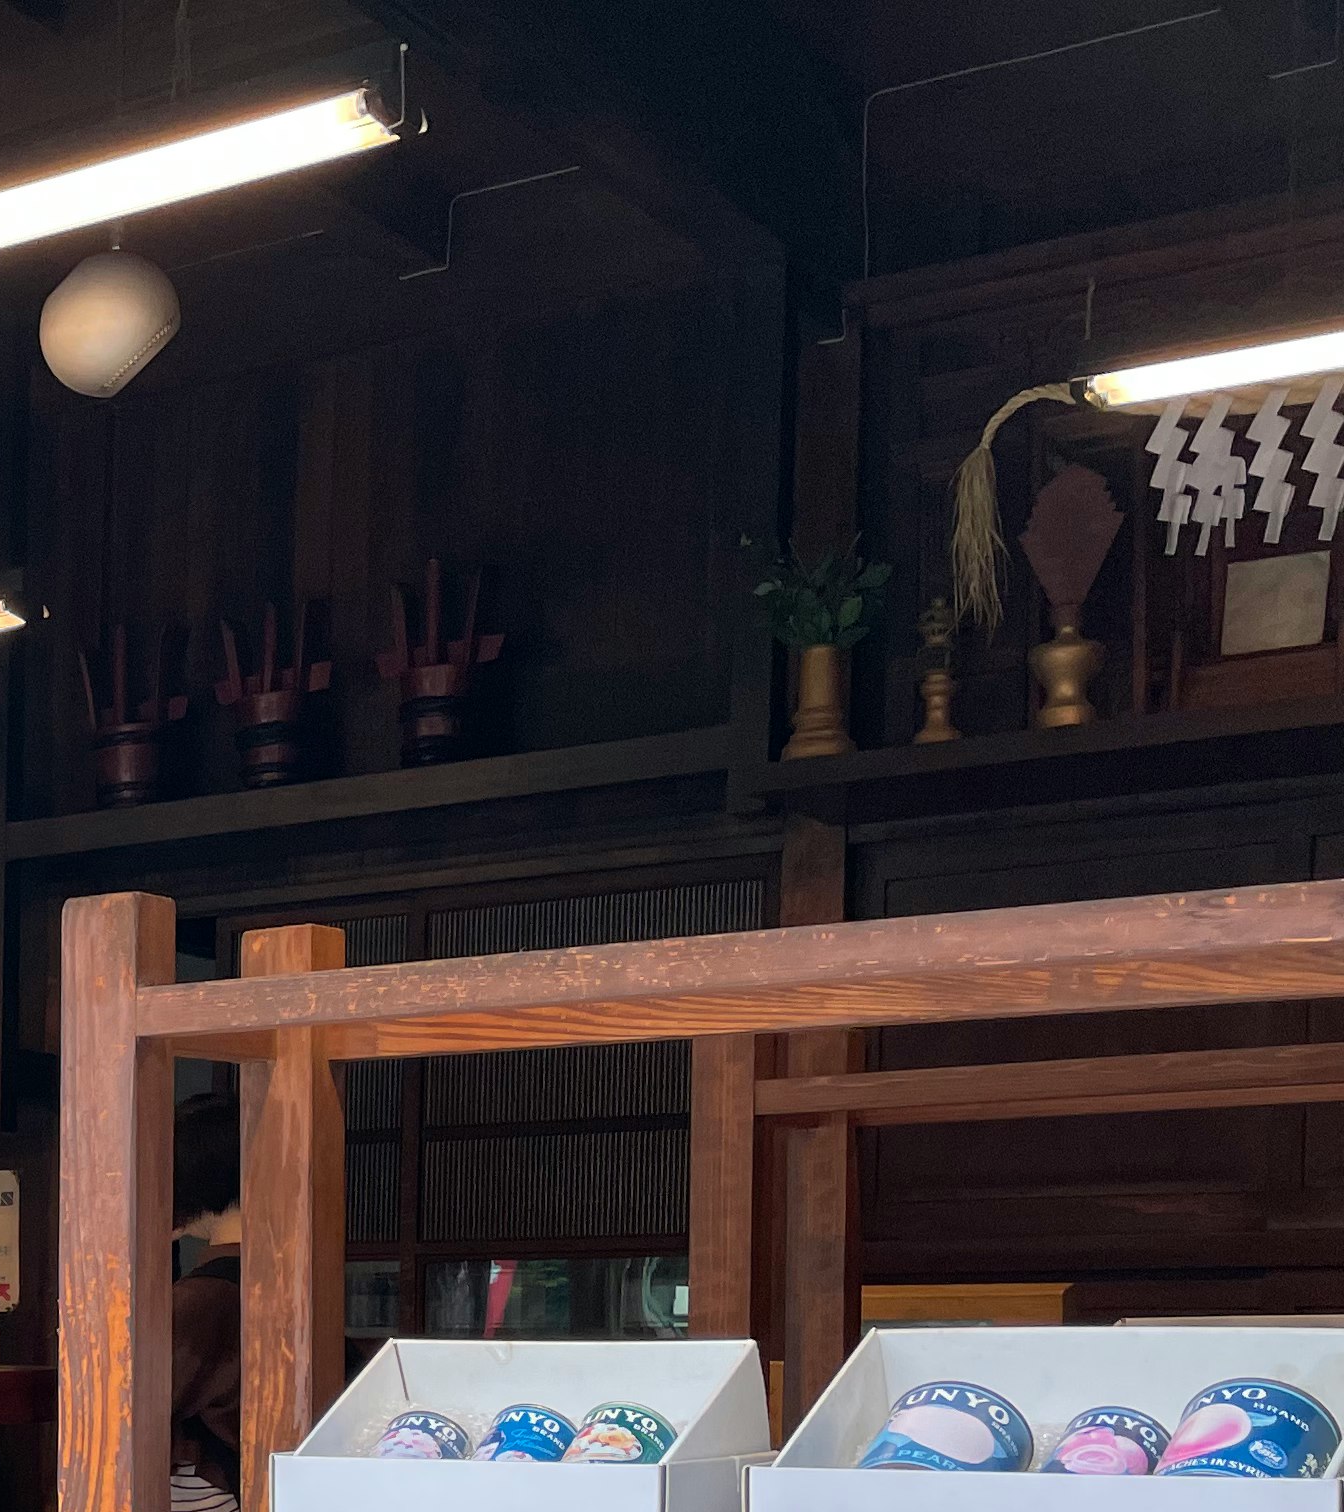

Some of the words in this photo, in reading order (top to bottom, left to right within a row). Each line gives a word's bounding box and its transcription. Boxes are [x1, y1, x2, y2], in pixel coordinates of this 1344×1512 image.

[1253, 1401, 1310, 1432] BRAND
[532, 1426, 565, 1450] BRAND
[633, 1423, 665, 1450] BRAND
[1210, 1458, 1226, 1466] IN
